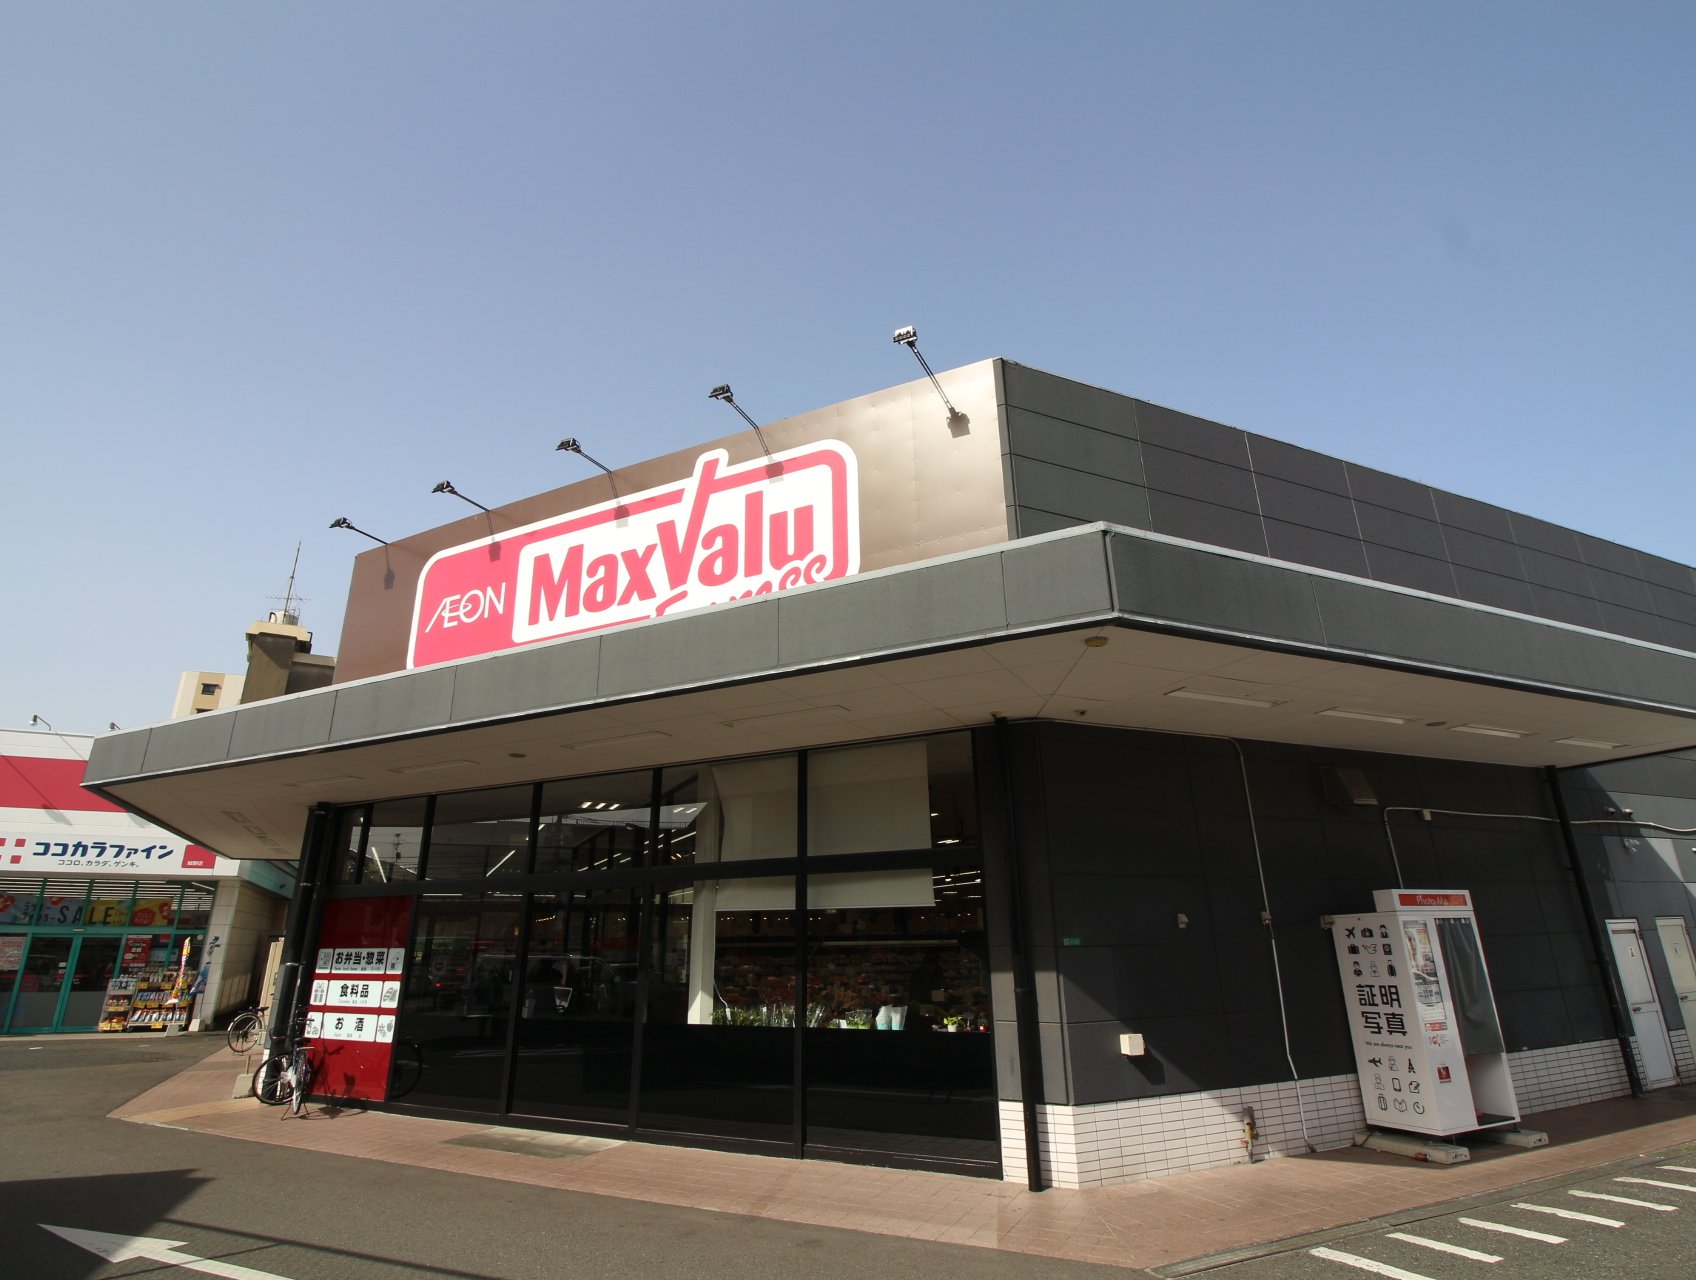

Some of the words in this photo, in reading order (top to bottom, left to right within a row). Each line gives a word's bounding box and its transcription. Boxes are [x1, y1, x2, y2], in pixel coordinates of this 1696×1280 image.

[527, 458, 815, 626] MaxValu
[33, 841, 174, 860] ココカラファイン
[57, 905, 115, 924] SALE
[340, 984, 369, 998] 食料品
[1356, 983, 1402, 1009] 証明
[1361, 1011, 1409, 1036] 写真
